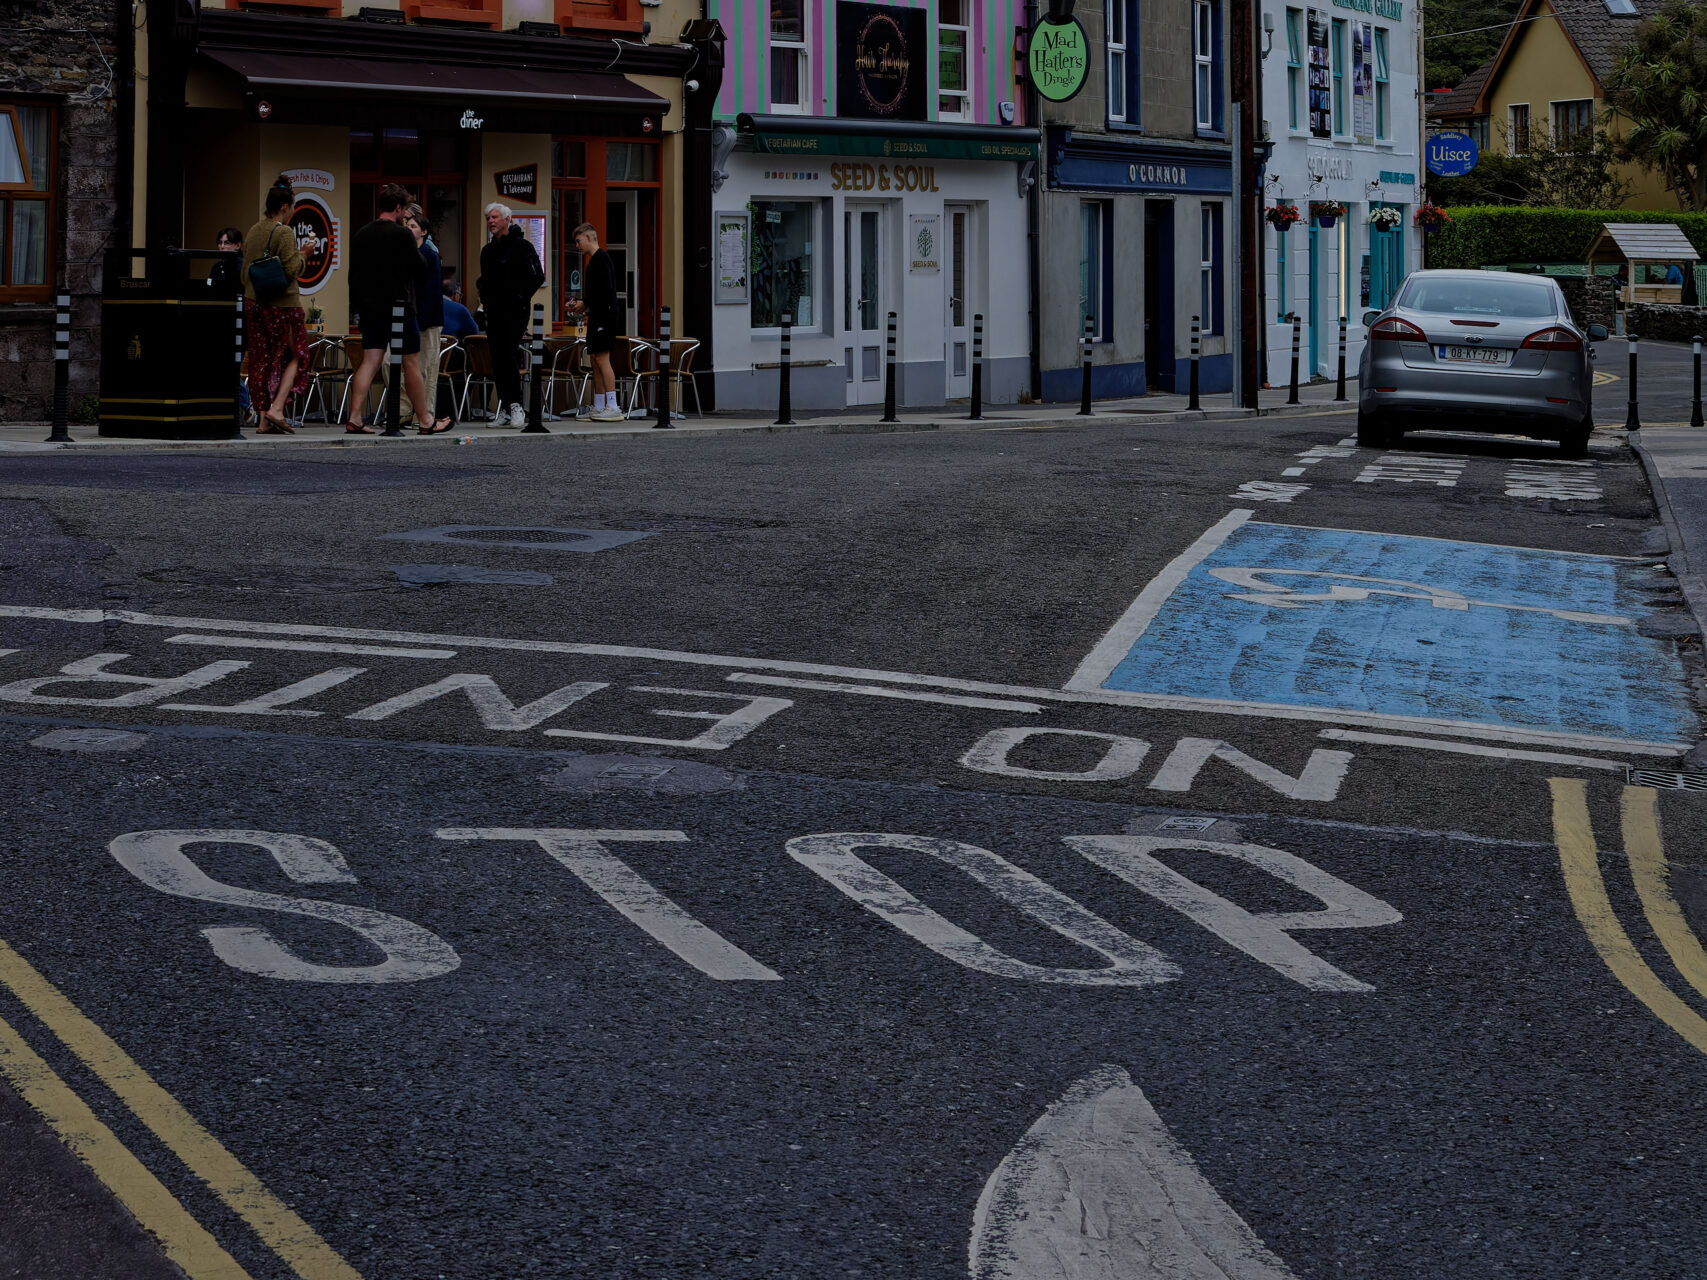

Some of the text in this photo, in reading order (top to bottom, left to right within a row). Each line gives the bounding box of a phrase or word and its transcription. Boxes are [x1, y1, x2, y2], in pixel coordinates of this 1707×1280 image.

[1042, 31, 1077, 50] Mad
[1033, 50, 1083, 72] Hatters
[1043, 69, 1075, 88] Dingle
[459, 111, 485, 130] diner
[465, 108, 475, 118] the
[893, 142, 908, 152] SEED
[913, 142, 928, 153] SOUL
[1431, 145, 1471, 161] Uisce
[502, 172, 534, 184] RESTAURANT
[831, 163, 939, 193] SEED & SOUL
[1129, 164, 1187, 185] O'CONNOR
[509, 184, 533, 195] Takeaway
[297, 221, 313, 236] the
[119, 279, 152, 288] Bruscar
[1451, 348, 1498, 360] 08-KY-779
[958, 725, 1355, 802] NO
[109, 828, 1404, 993] STOP
